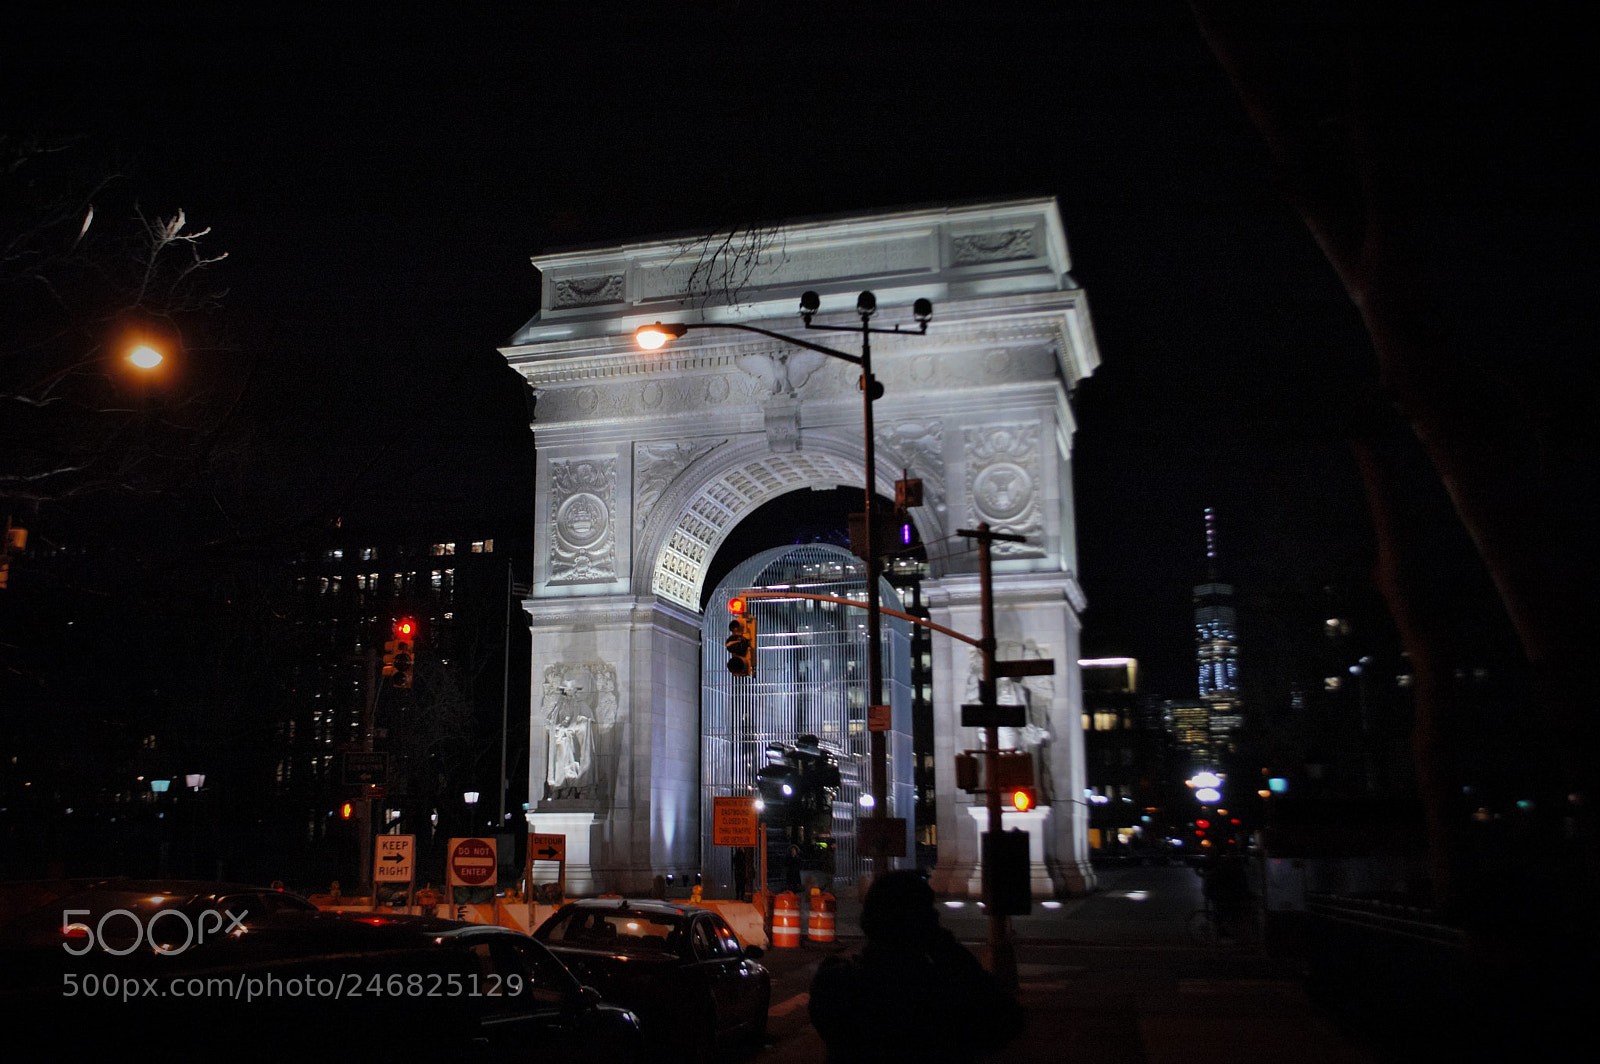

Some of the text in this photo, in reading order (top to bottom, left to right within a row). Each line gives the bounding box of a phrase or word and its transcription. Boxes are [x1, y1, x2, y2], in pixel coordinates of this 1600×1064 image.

[534, 836, 562, 845] DETOUR
[382, 841, 408, 850] KEEP
[458, 847, 490, 855] DO NOT
[379, 866, 409, 876] RIGHT
[461, 867, 487, 876] ENTER
